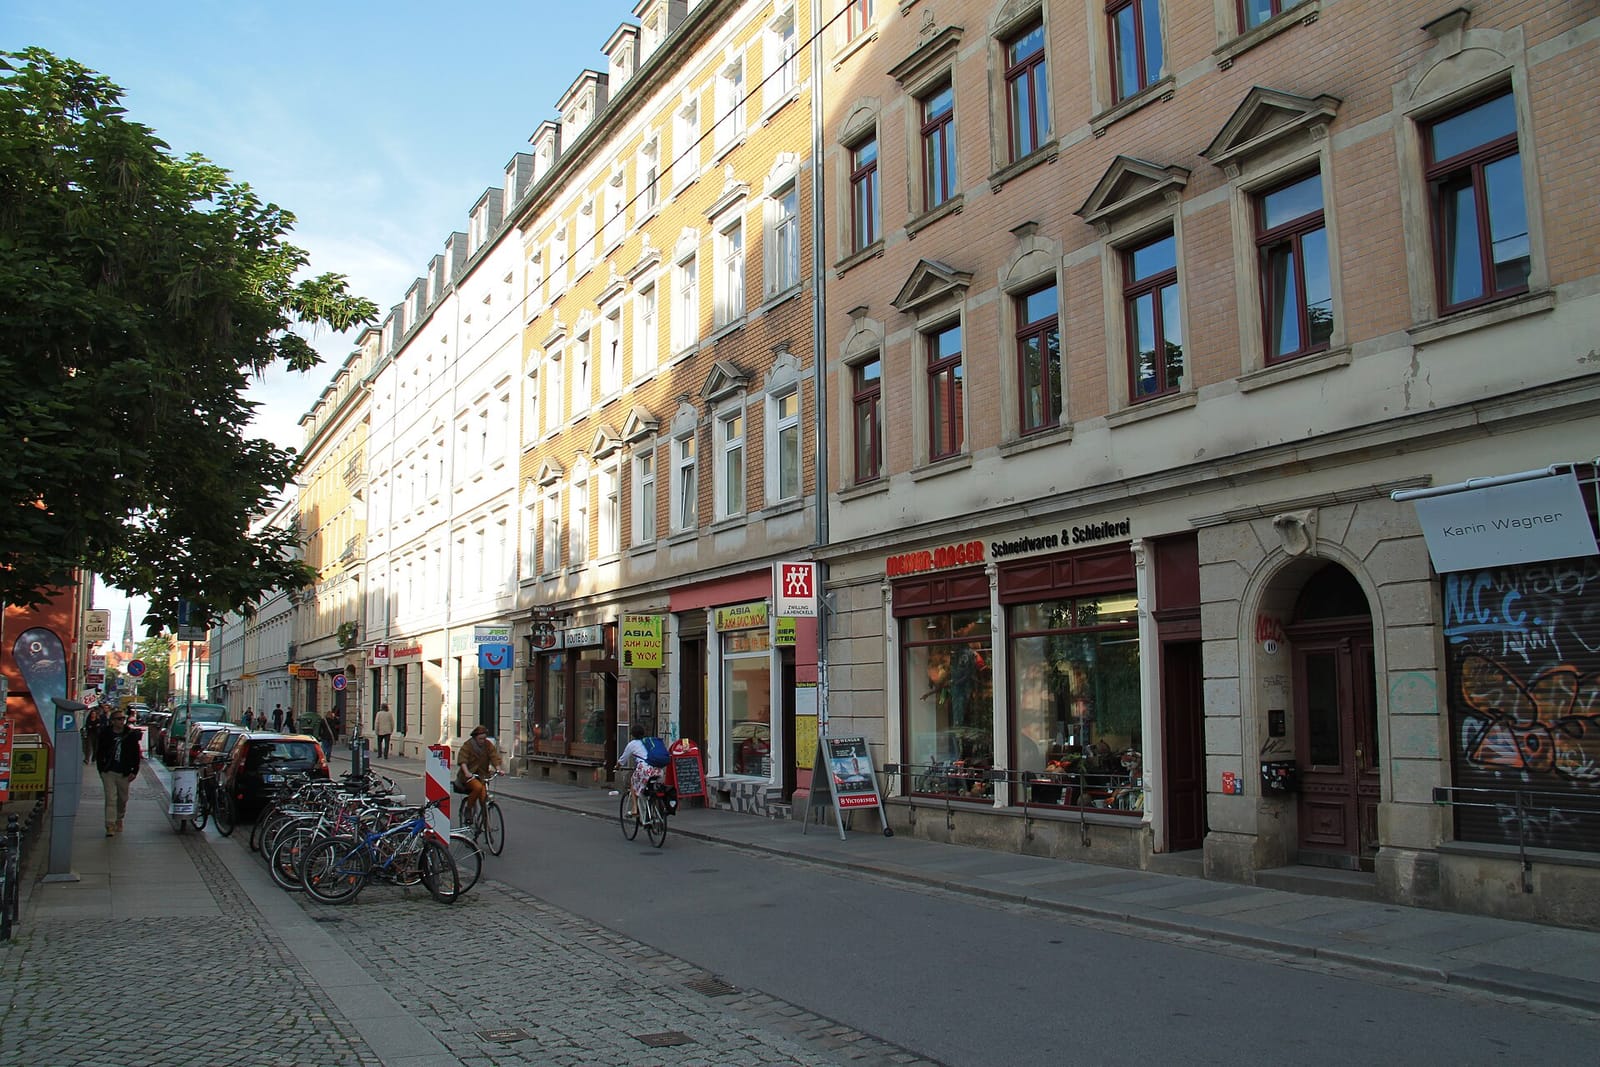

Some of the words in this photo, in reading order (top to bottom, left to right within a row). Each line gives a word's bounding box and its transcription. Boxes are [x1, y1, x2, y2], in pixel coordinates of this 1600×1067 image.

[1442, 523, 1486, 537] Karin
[1491, 512, 1563, 530] Wagner
[990, 533, 1059, 559] Schneidwaren
[1061, 529, 1070, 545] &
[1072, 517, 1131, 545] Schleiferei
[730, 606, 751, 616] ASIA
[86, 624, 105, 633] Café
[1267, 642, 1276, 652] 10
[636, 652, 657, 660] WOK
[62, 714, 73, 730] P
